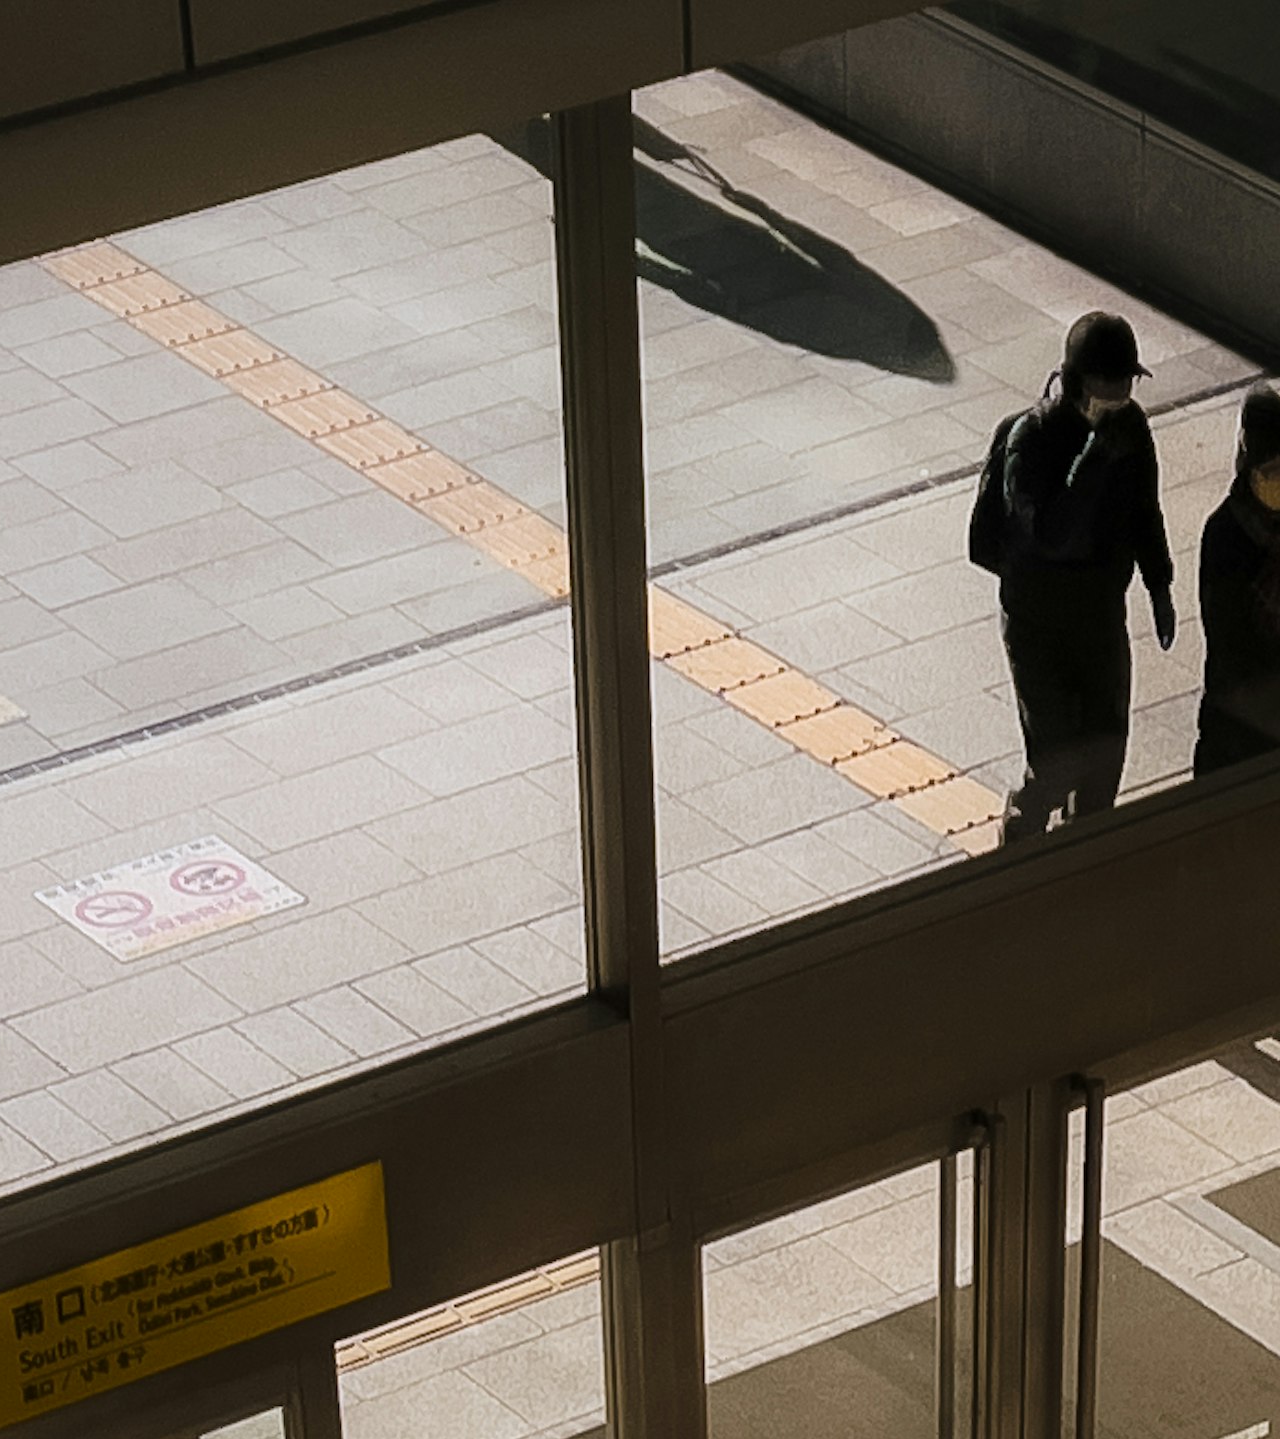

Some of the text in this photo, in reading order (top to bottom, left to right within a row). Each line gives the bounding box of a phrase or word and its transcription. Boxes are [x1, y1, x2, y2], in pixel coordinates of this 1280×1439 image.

[12, 1286, 86, 1340] 南口
[19, 1320, 125, 1373] South Exit
